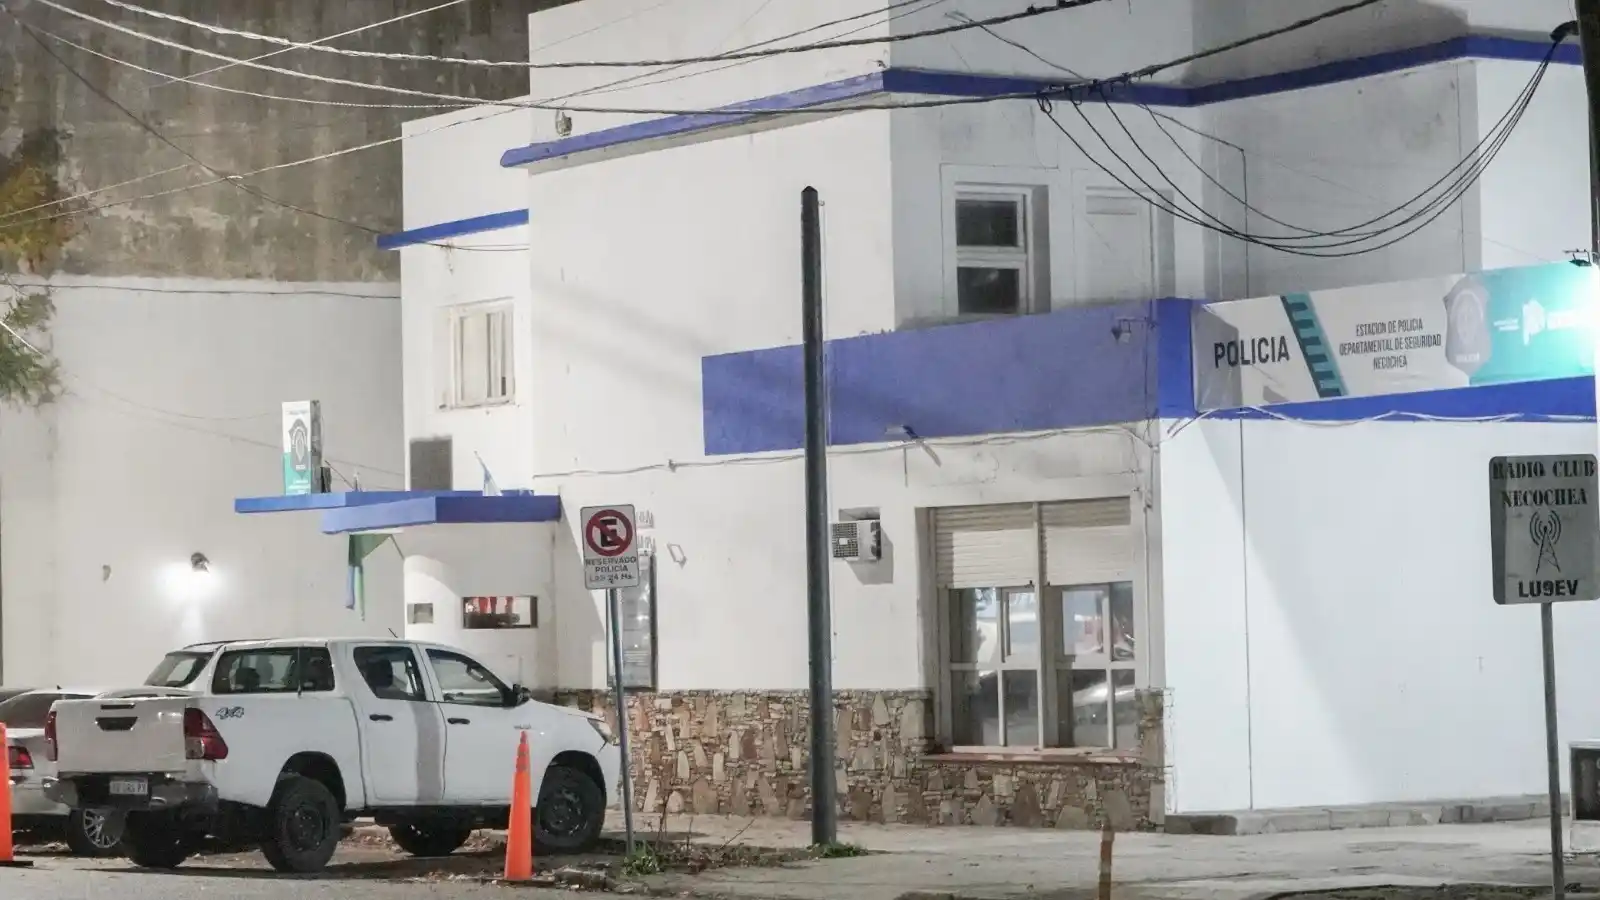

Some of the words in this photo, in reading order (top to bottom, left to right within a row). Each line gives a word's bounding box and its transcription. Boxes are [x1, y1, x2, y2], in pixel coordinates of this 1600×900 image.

[1356, 322, 1387, 337] ESTACION
[1387, 320, 1397, 333] DE
[1397, 318, 1423, 333] POLICIA
[1214, 335, 1290, 369] POLICIA
[1339, 339, 1393, 356] DEPARTAMENTAL
[1394, 336, 1404, 350] DE
[1404, 334, 1442, 350] SEGURIDAD
[1373, 355, 1408, 370] NECOCHEA
[1492, 461, 1546, 479] RADIO
[1552, 460, 1595, 477] CLUB
[1501, 488, 1588, 507] NECOCHEA
[585, 556, 637, 566] RESERVADO
[595, 565, 628, 573] POLICIA
[1518, 579, 1579, 598] LU9EV
